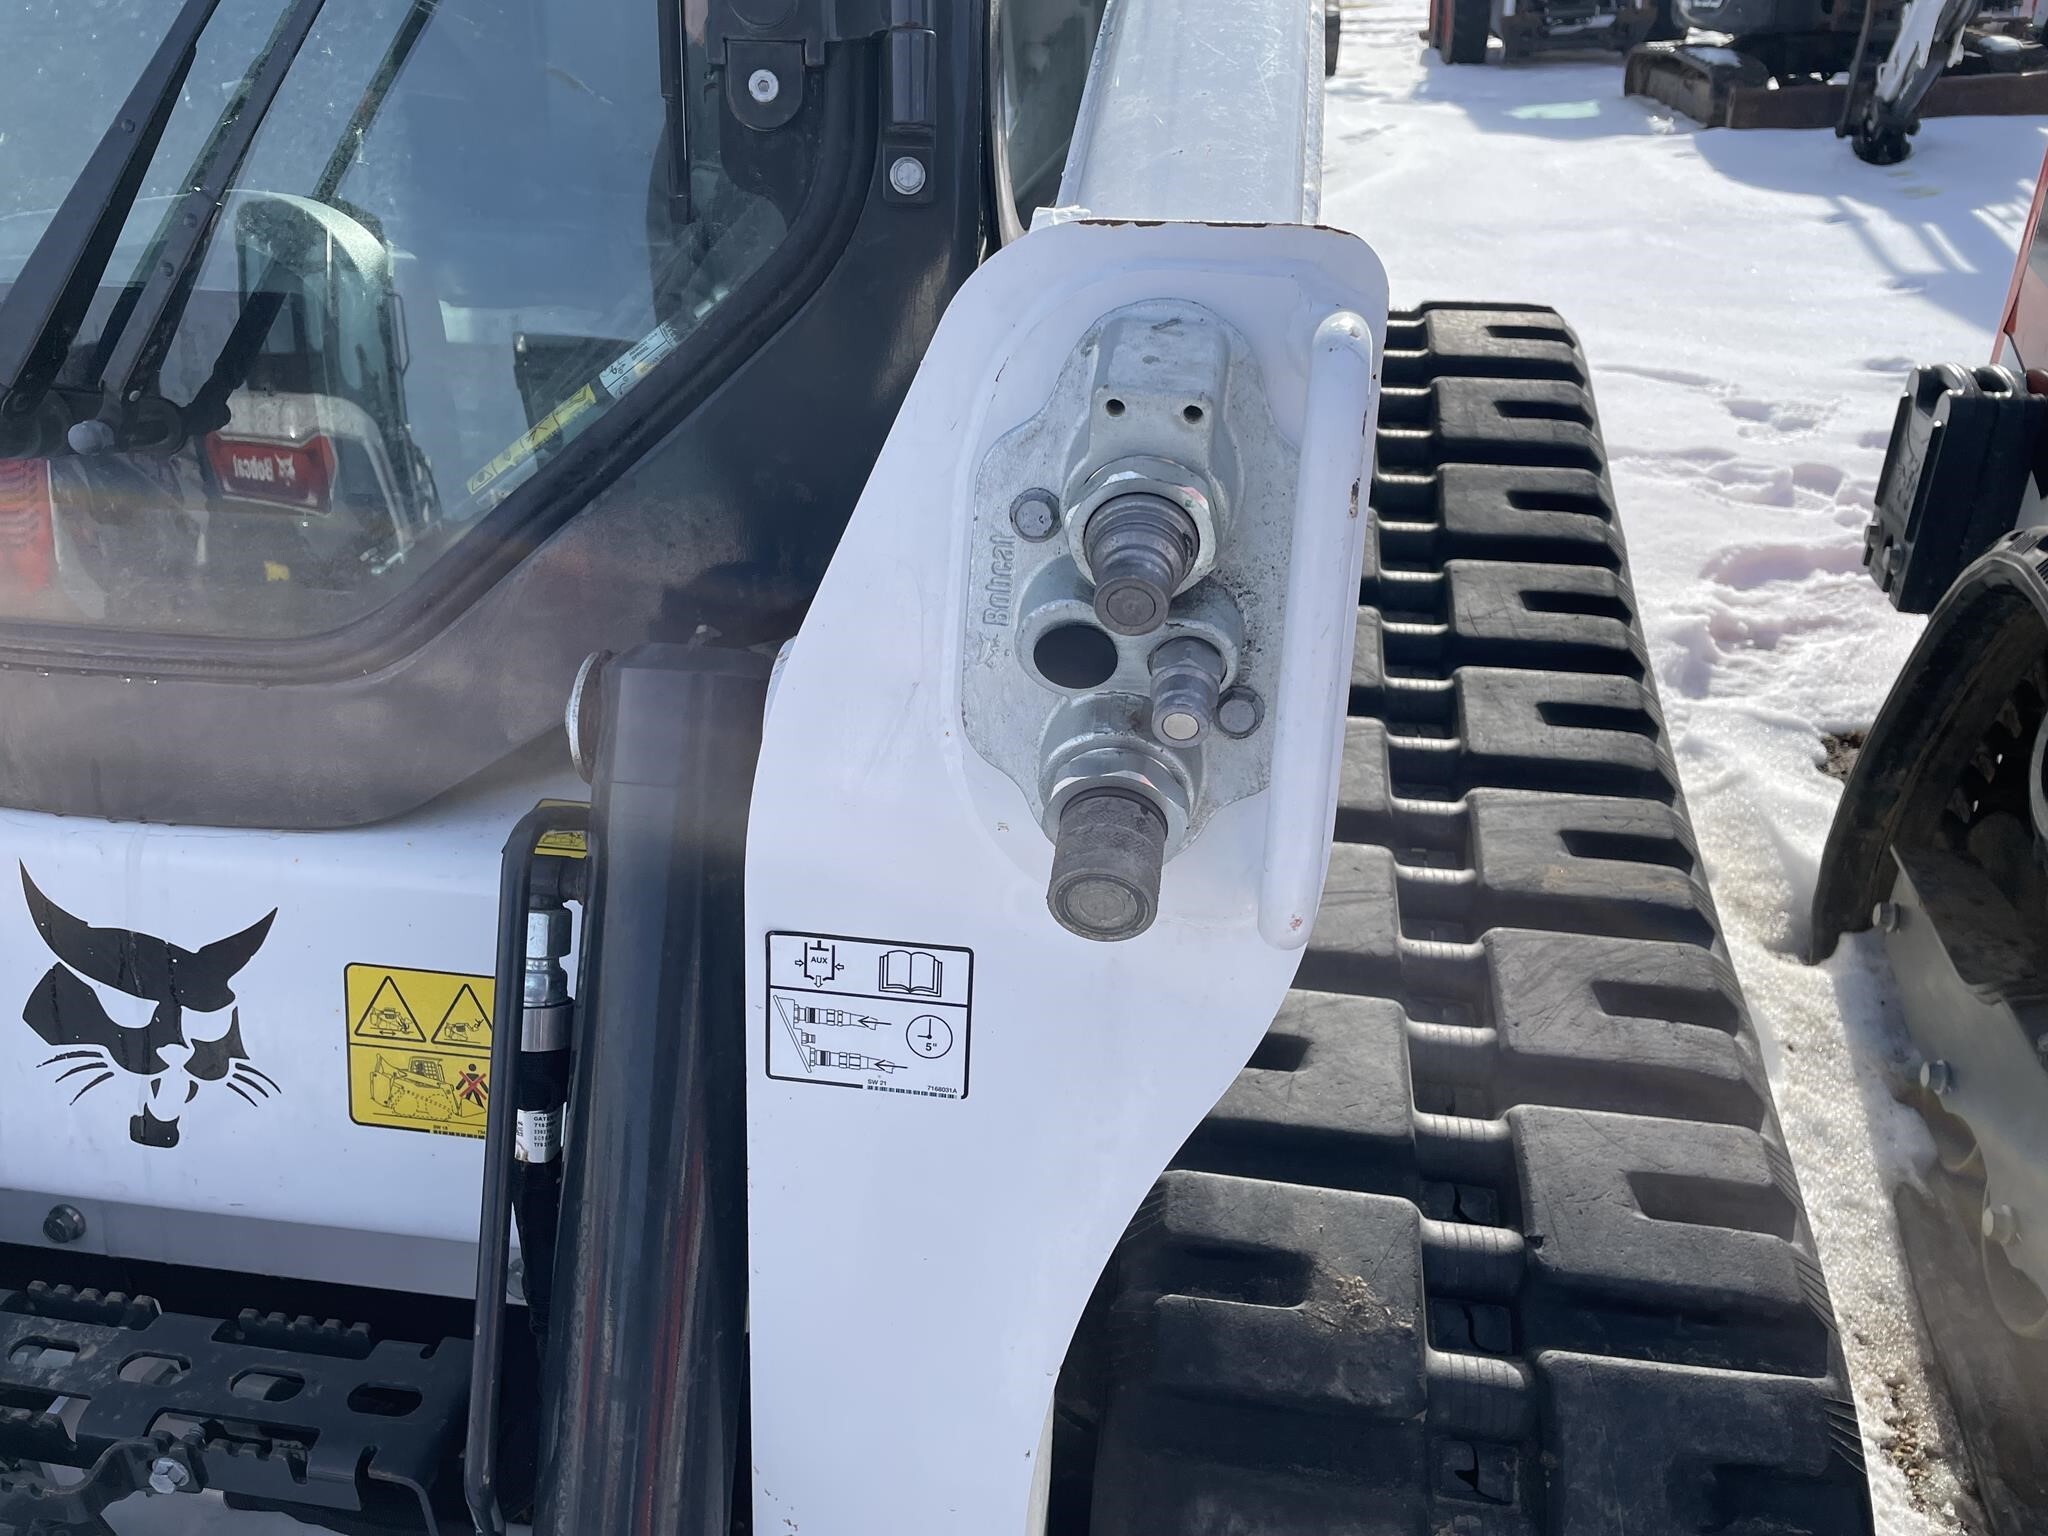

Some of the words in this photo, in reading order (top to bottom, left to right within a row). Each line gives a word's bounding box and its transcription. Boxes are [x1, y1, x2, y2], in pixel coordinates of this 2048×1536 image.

[982, 534, 1016, 626] Bobcat
[810, 955, 828, 965] AUX
[867, 1078, 878, 1086] SW
